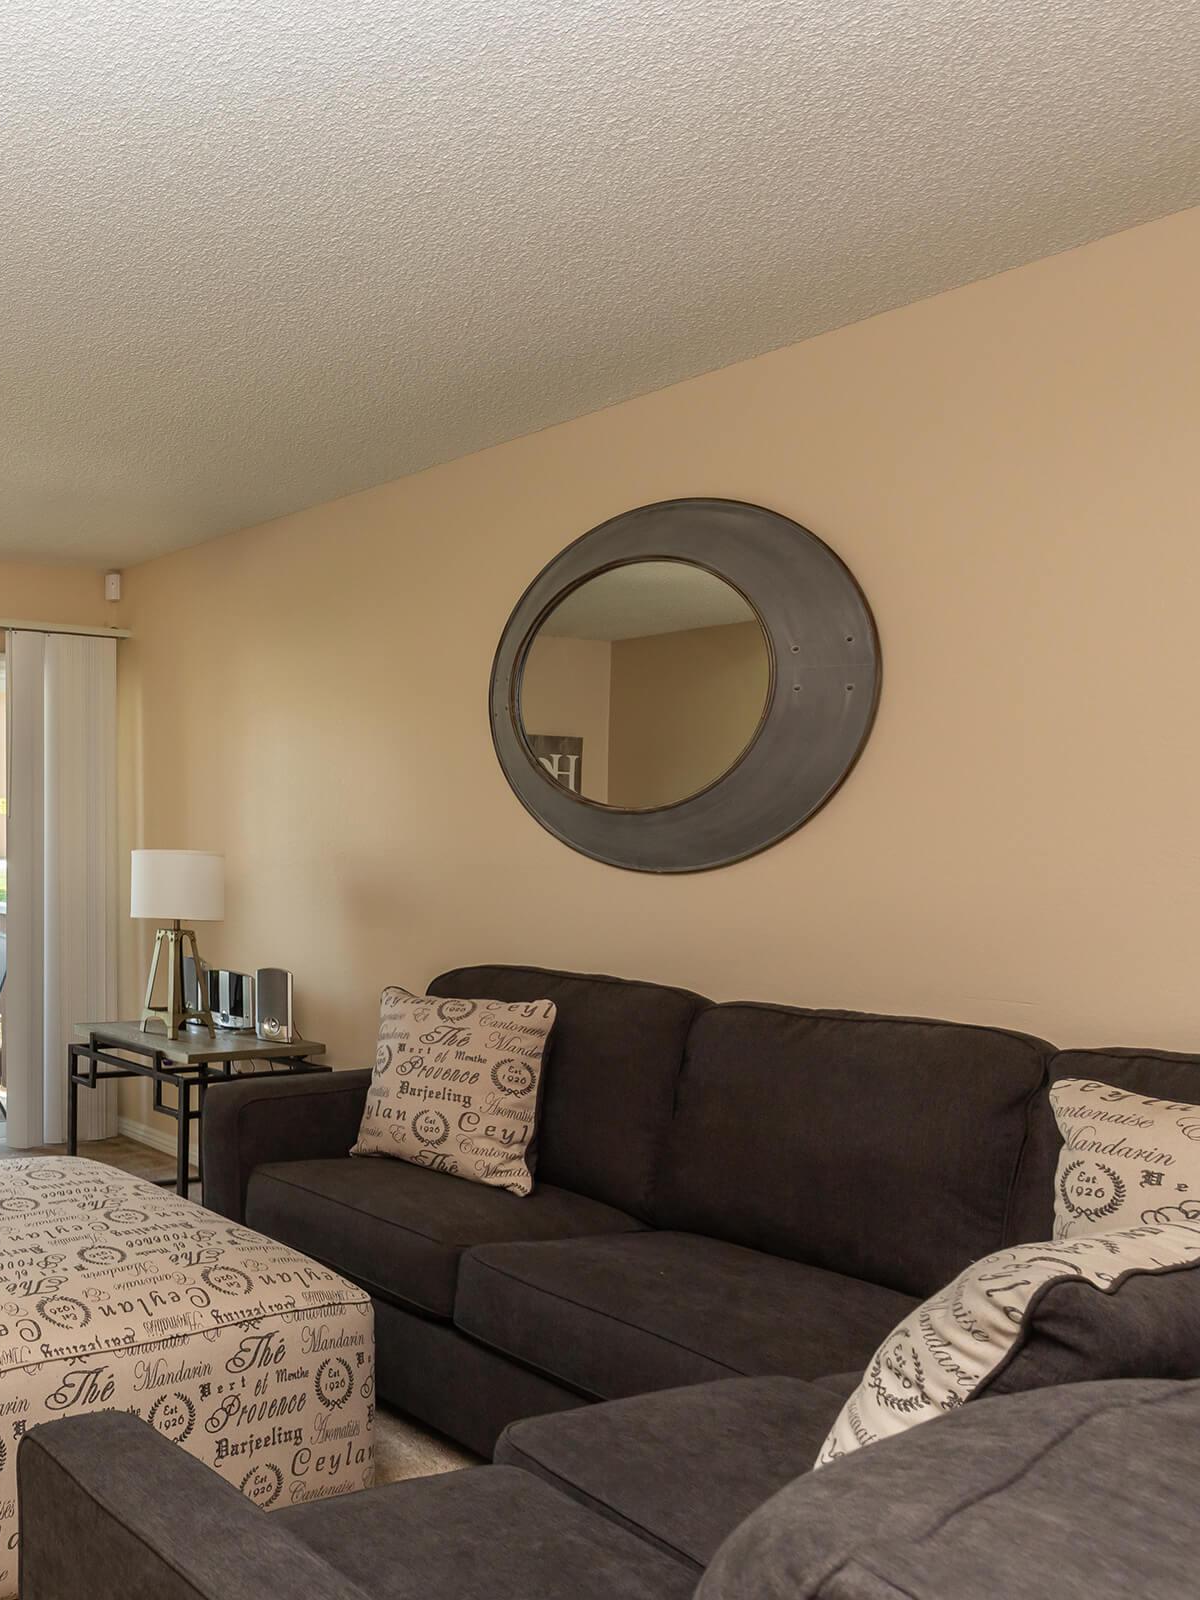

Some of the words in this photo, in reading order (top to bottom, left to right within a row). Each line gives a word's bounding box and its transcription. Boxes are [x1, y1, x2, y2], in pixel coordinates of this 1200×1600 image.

[486, 1003, 554, 1019] Ceyl
[420, 1025, 471, 1047] Thé
[455, 1050, 487, 1064] Menthe
[396, 1055, 480, 1084] Provence
[508, 1065, 521, 1074] Est
[397, 1080, 472, 1108] Darjeeling
[424, 1117, 435, 1125] Est
[458, 1111, 528, 1144] Ceyl
[1070, 1185, 1105, 1198] 1926
[8, 1221, 109, 1241] Ceylan
[125, 1231, 216, 1248] Provence
[99, 1286, 211, 1317] Ceylan
[301, 1325, 364, 1354] Mandarin
[225, 1330, 287, 1373] Thé
[133, 1358, 213, 1391] Mandarin
[275, 1367, 309, 1383] Menthe
[328, 1368, 339, 1378] Est
[45, 1366, 115, 1410] Thé
[163, 1405, 178, 1416] Est
[205, 1392, 307, 1433] Provence
[213, 1427, 303, 1467] Darjeeling
[254, 1475, 267, 1484] Est
